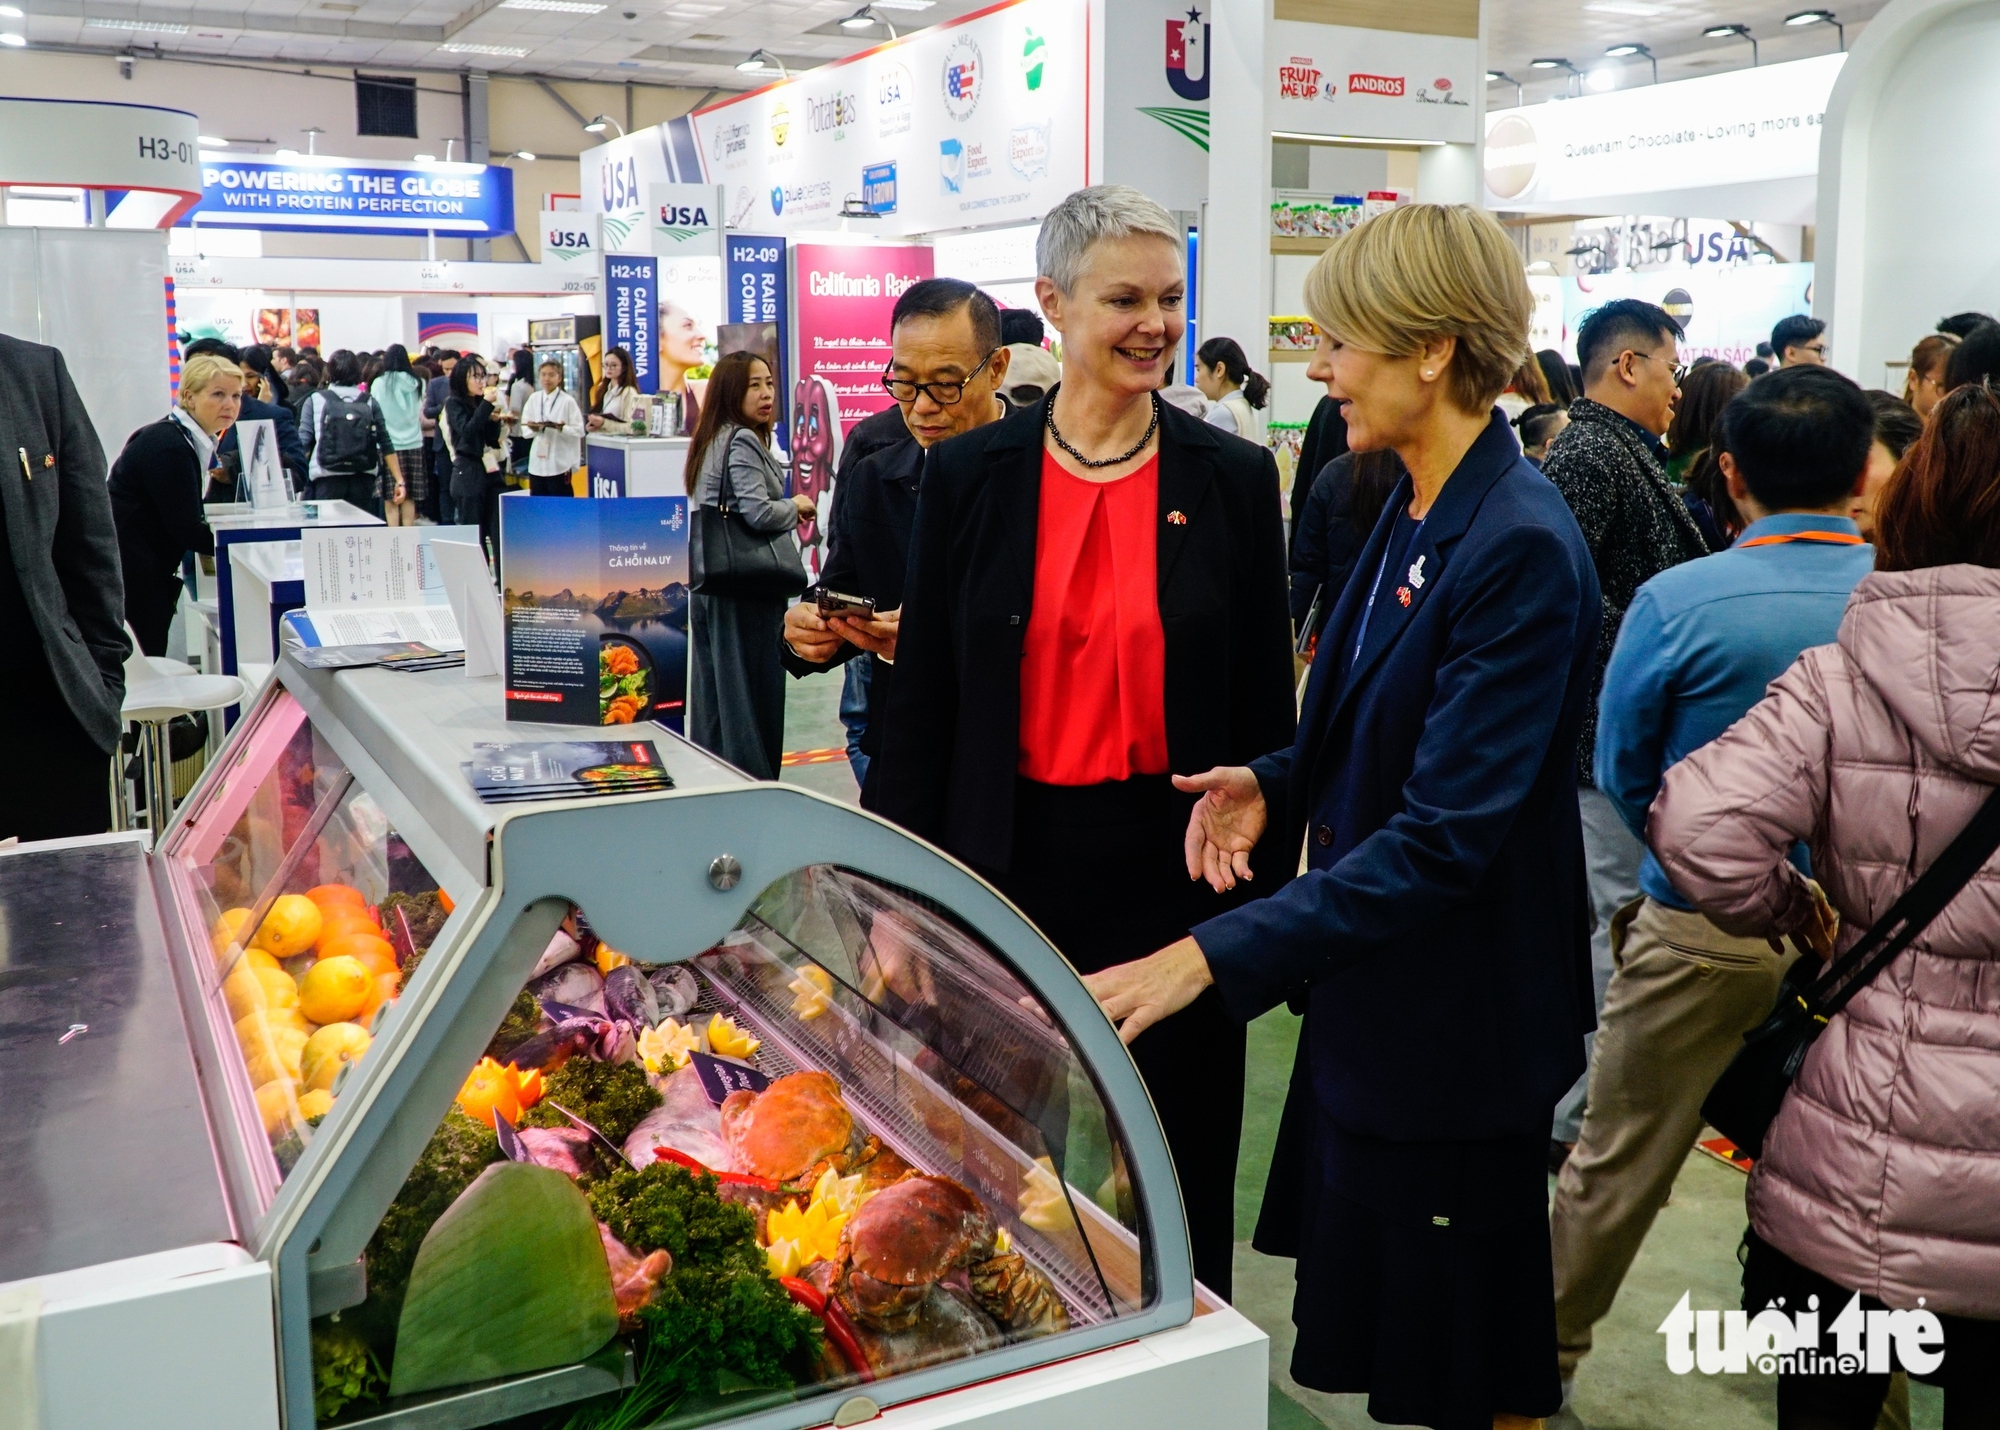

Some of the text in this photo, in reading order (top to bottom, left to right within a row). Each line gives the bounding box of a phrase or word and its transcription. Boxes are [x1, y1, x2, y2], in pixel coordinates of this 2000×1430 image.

[1279, 66, 1321, 84] FRUIT
[1281, 83, 1318, 98] ME UP
[1351, 76, 1402, 94] ANDROS
[880, 84, 901, 105] USA
[1012, 132, 1028, 147] Food
[1628, 130, 1696, 150] Chocolate
[1707, 121, 1756, 138] Loving
[1762, 115, 1800, 132] more
[138, 136, 193, 165] H3-01
[967, 143, 982, 156] Food
[1012, 147, 1034, 161] Export
[967, 156, 988, 170] Export
[202, 168, 481, 199] POWERING THE GLOBE
[602, 156, 639, 212] USA
[223, 192, 464, 214] WITH PROTEIN PERFECTION
[661, 206, 708, 226] USA
[550, 230, 590, 248] USA
[734, 247, 779, 262] H2-09
[611, 265, 651, 279] H2-15
[562, 282, 596, 291] J02-05
[809, 270, 880, 297] California
[617, 287, 631, 339] PRUNE
[634, 287, 649, 378] CALIFORNIA
[594, 476, 618, 498] USA
[630, 543, 638, 551] tin
[608, 552, 671, 567] CÁ HỒI NA UY
